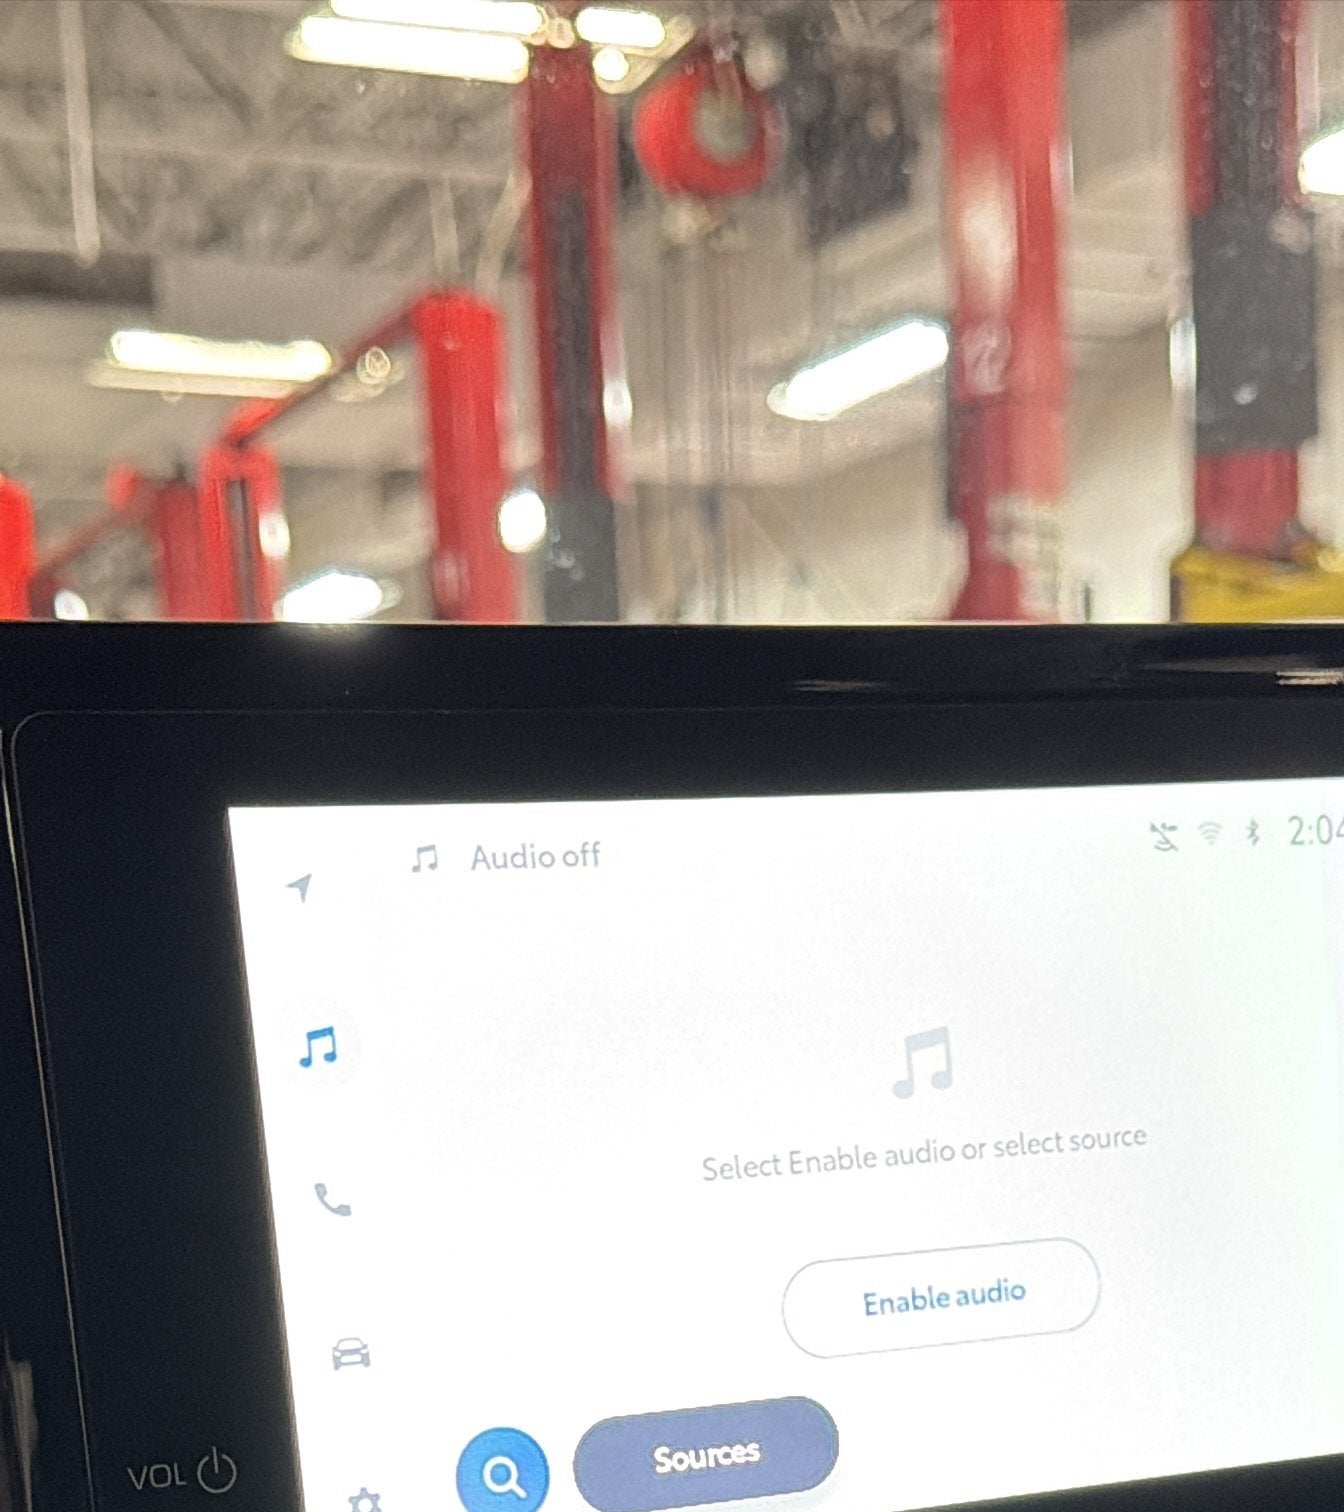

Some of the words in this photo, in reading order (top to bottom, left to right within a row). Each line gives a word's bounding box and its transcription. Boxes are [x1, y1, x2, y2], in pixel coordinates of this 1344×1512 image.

[470, 842, 556, 871] Audio
[562, 840, 601, 868] off
[702, 1153, 782, 1182] Select
[789, 1144, 878, 1175] Enable
[884, 1138, 956, 1168] audio
[961, 1143, 987, 1160] or
[993, 1131, 1064, 1159] select
[1069, 1128, 1148, 1152] source
[863, 1284, 951, 1317] Enable
[956, 1278, 1027, 1308] audio
[653, 1442, 761, 1474] Sources
[127, 1461, 187, 1490] VOL
